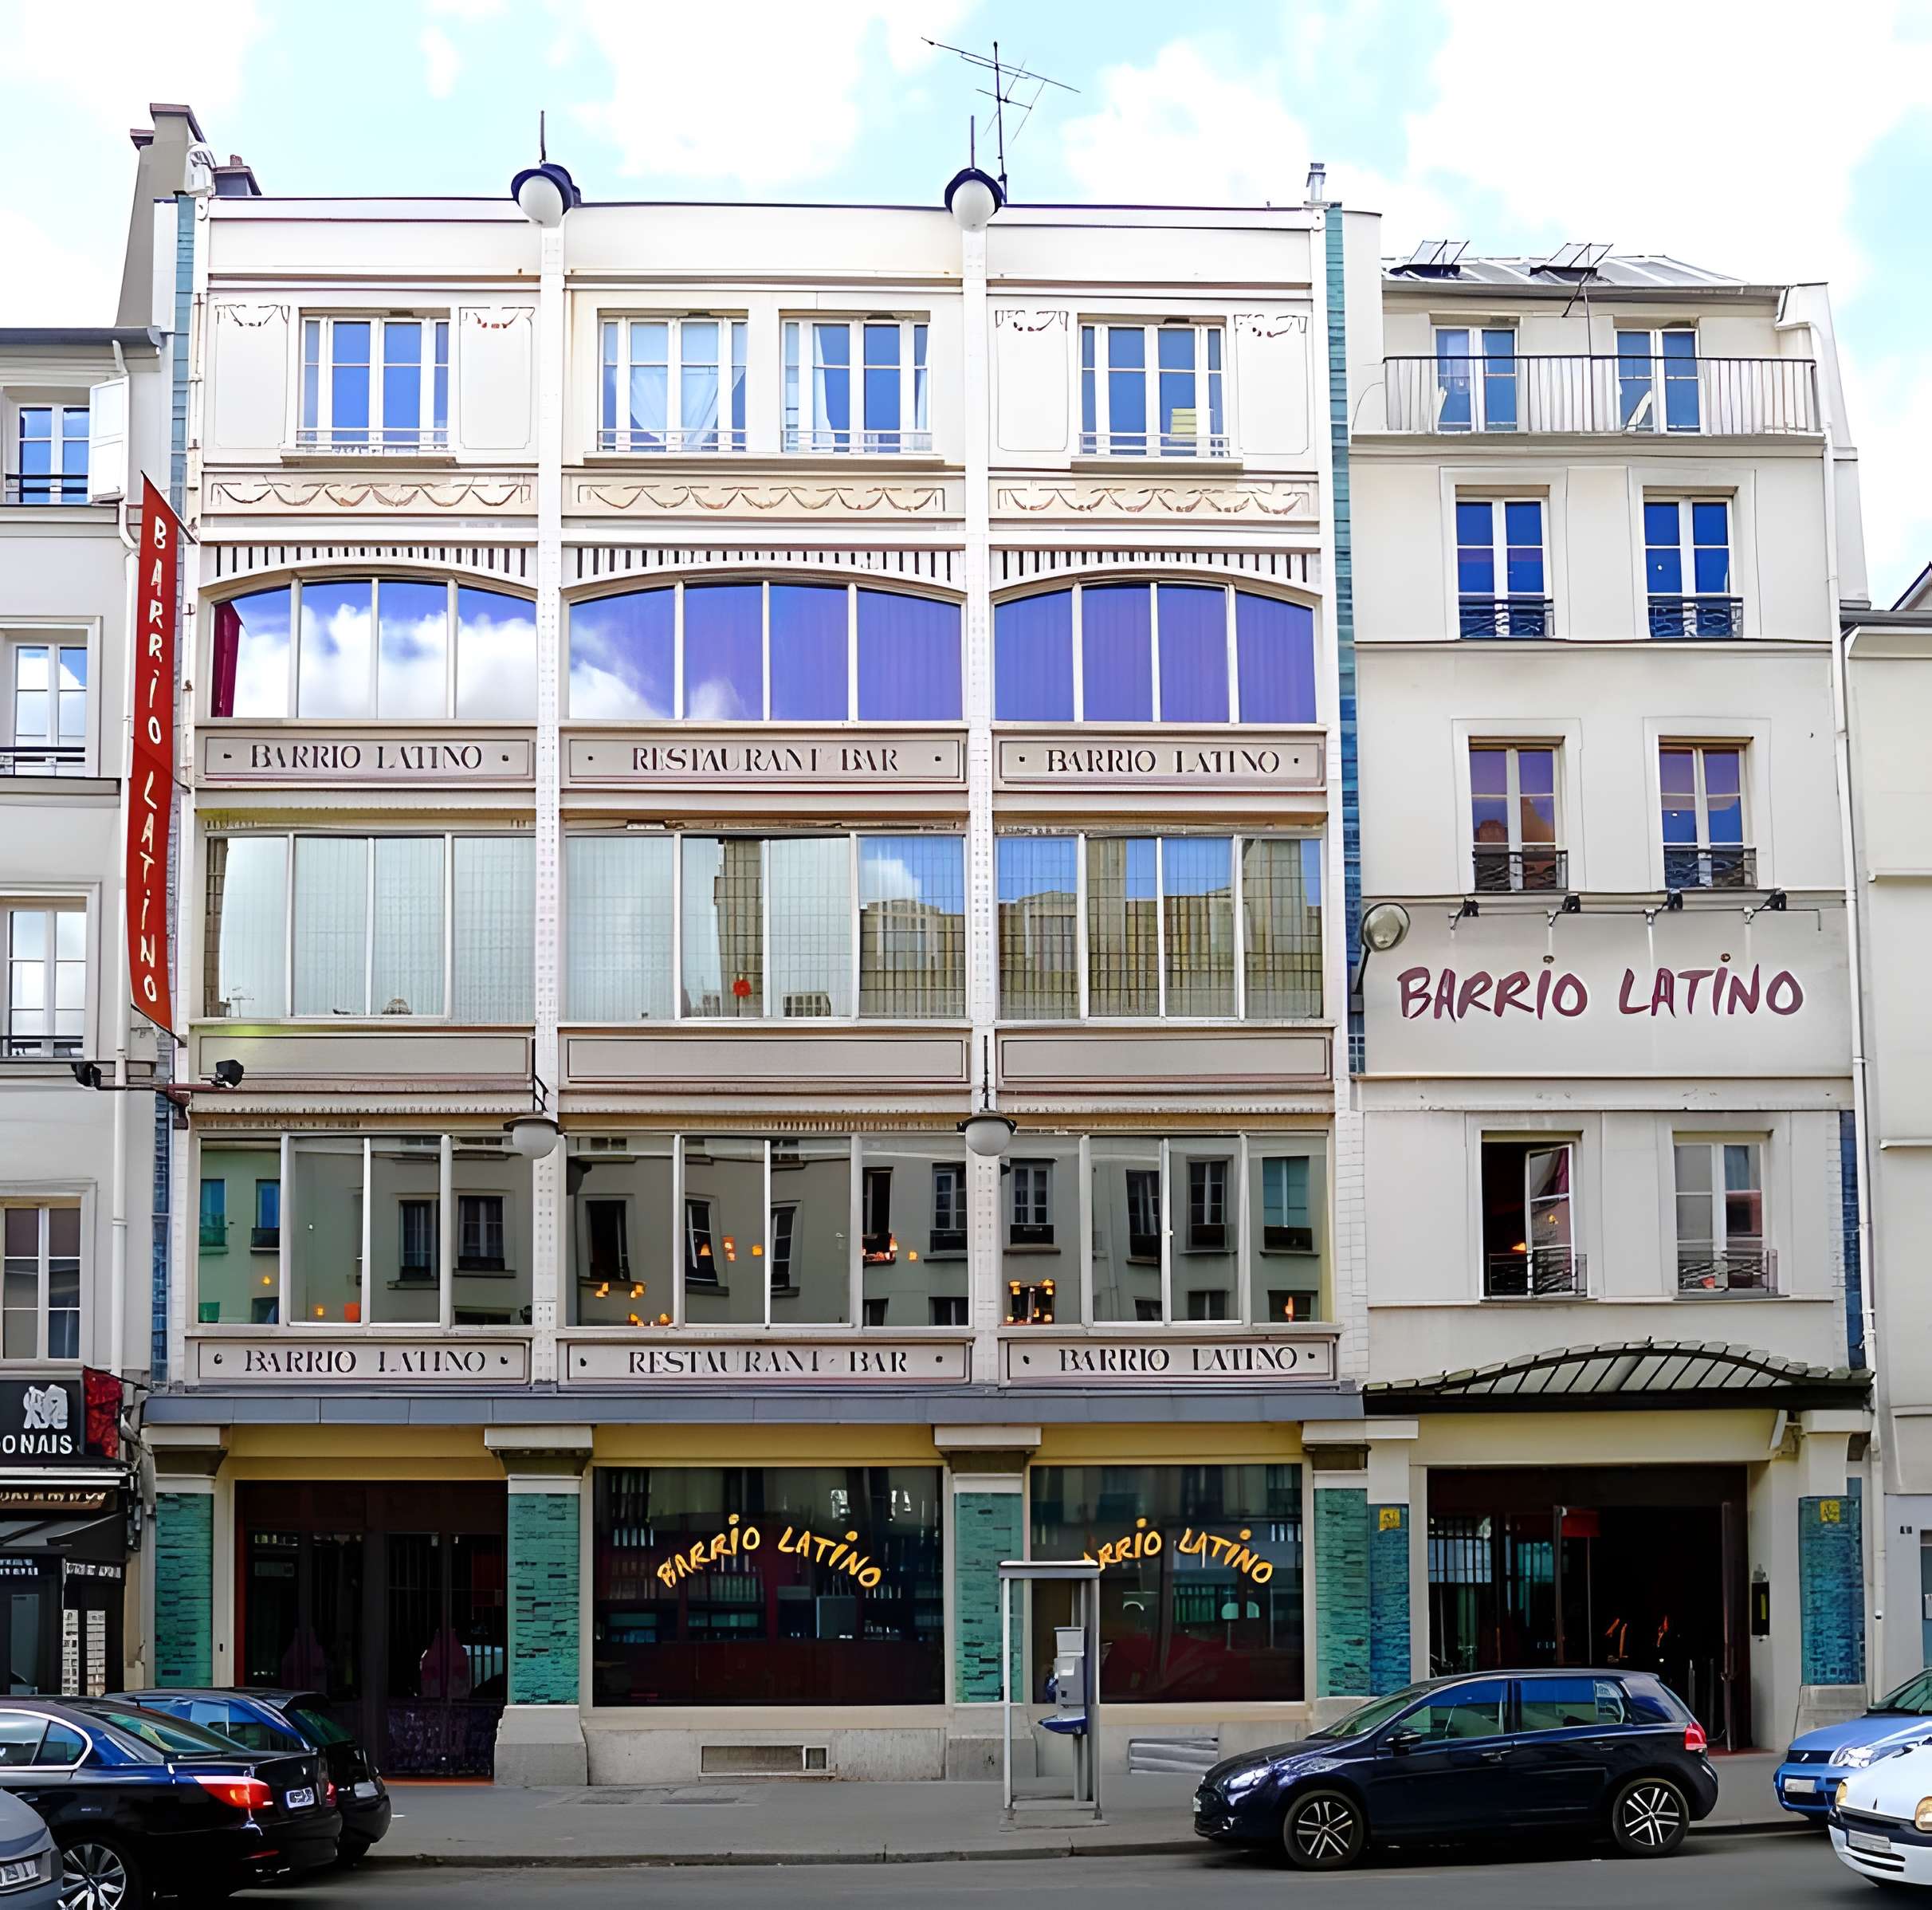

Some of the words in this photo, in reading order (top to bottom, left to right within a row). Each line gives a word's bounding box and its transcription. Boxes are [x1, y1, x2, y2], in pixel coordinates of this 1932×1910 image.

[251, 744, 361, 769] BARRIO
[377, 745, 483, 770] LATINO
[633, 747, 822, 772] RESTAURANT
[842, 748, 898, 772] BAR
[1046, 749, 1156, 772] BARRIO
[1173, 749, 1280, 773] LATINO
[245, 1350, 357, 1373] BARRIO
[378, 1350, 486, 1373] LATINO
[629, 1350, 823, 1374] RESTAURANT
[850, 1350, 908, 1373] BAR
[1058, 1348, 1170, 1371] BARRIO
[1192, 1346, 1298, 1370] LATINO
[0, 1434, 73, 1454] ONAIS
